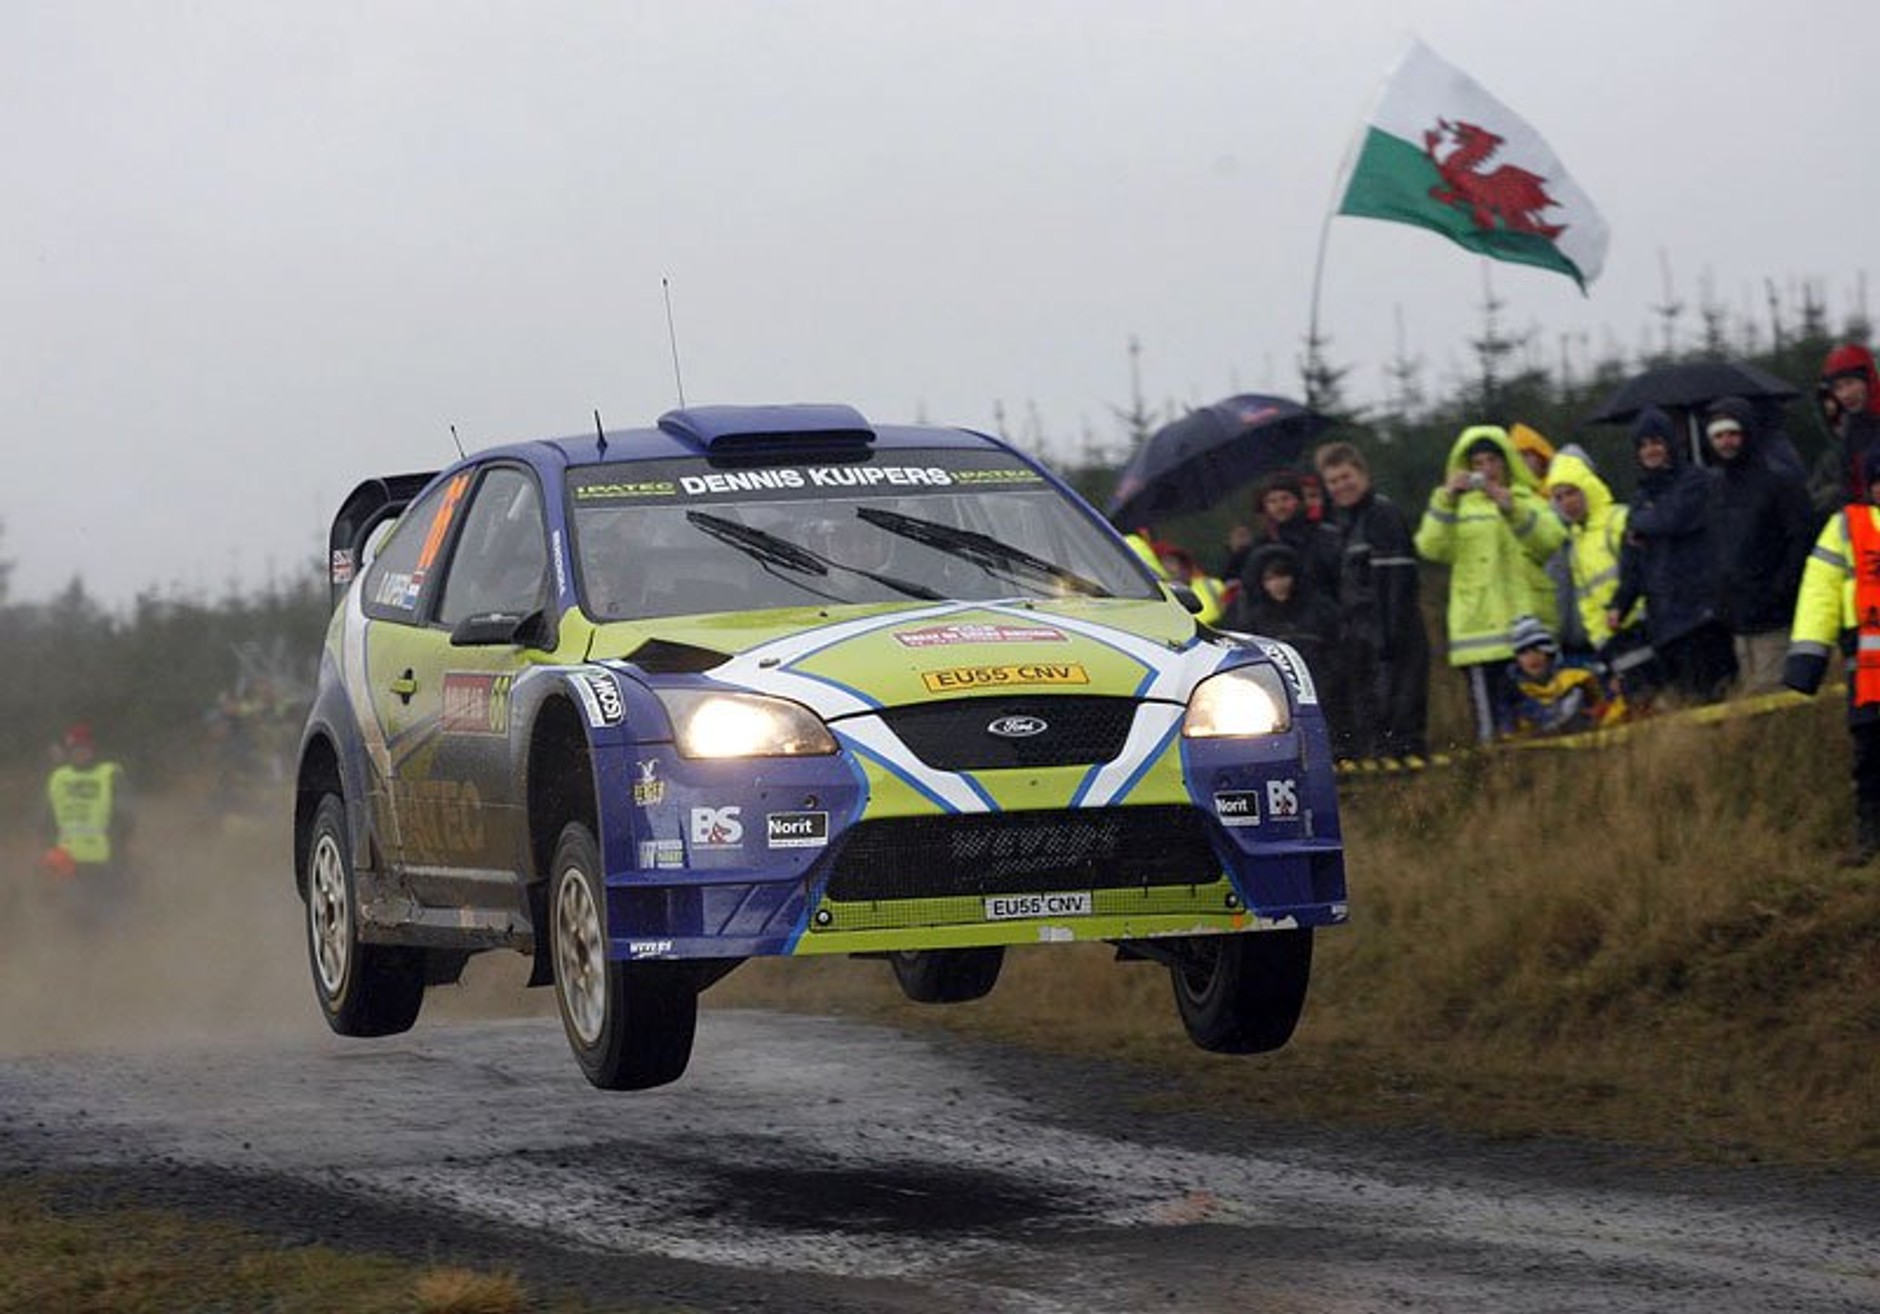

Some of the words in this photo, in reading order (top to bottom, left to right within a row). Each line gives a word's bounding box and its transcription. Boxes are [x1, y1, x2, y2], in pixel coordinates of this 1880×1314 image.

[679, 470, 804, 495] DENNIS
[810, 466, 952, 486] KUIPERS
[937, 669, 1008, 686] EU55
[1017, 666, 1069, 679] CNV
[1003, 719, 1033, 731] Ford
[1215, 799, 1249, 812] Norit
[1265, 780, 1299, 816] B&S
[691, 806, 743, 844] B&S
[769, 818, 812, 834] Norit
[993, 900, 1039, 915] EU55
[1048, 897, 1085, 912] CNV
